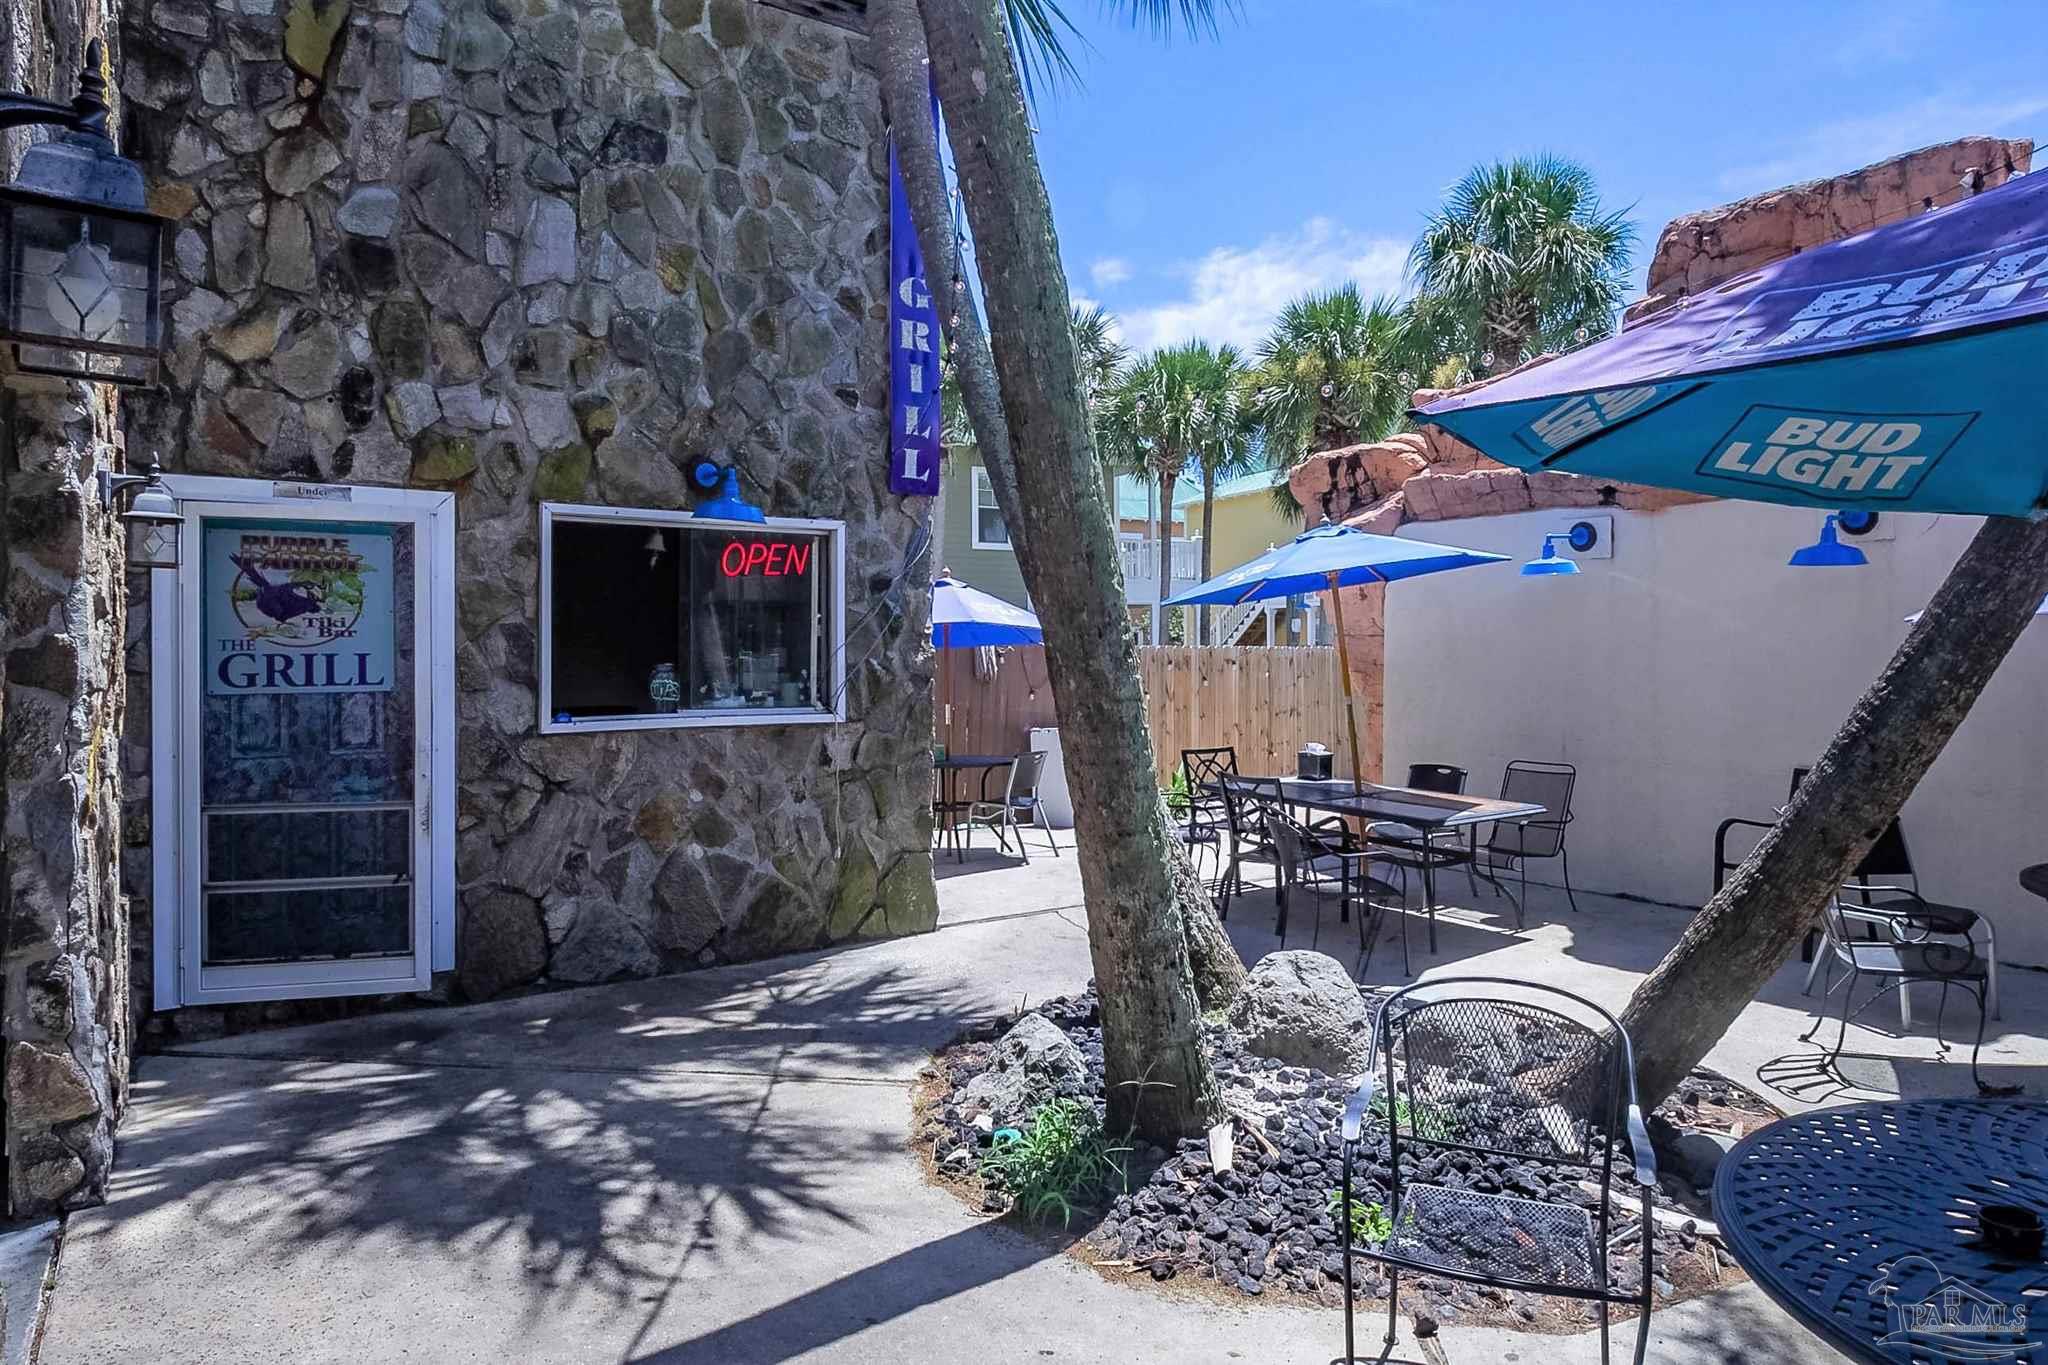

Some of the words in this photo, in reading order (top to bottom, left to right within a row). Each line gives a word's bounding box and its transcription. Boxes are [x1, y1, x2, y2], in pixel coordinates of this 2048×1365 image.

[1693, 277, 2048, 357] LIGH
[899, 276, 931, 481] GRILL
[1766, 416, 1922, 455] BUD
[1714, 441, 1927, 491] LIGHT
[721, 542, 810, 578] OPEN
[302, 616, 347, 628] Tiki
[319, 627, 357, 638] Bar
[217, 639, 256, 651] THE
[217, 652, 384, 688] GRILL
